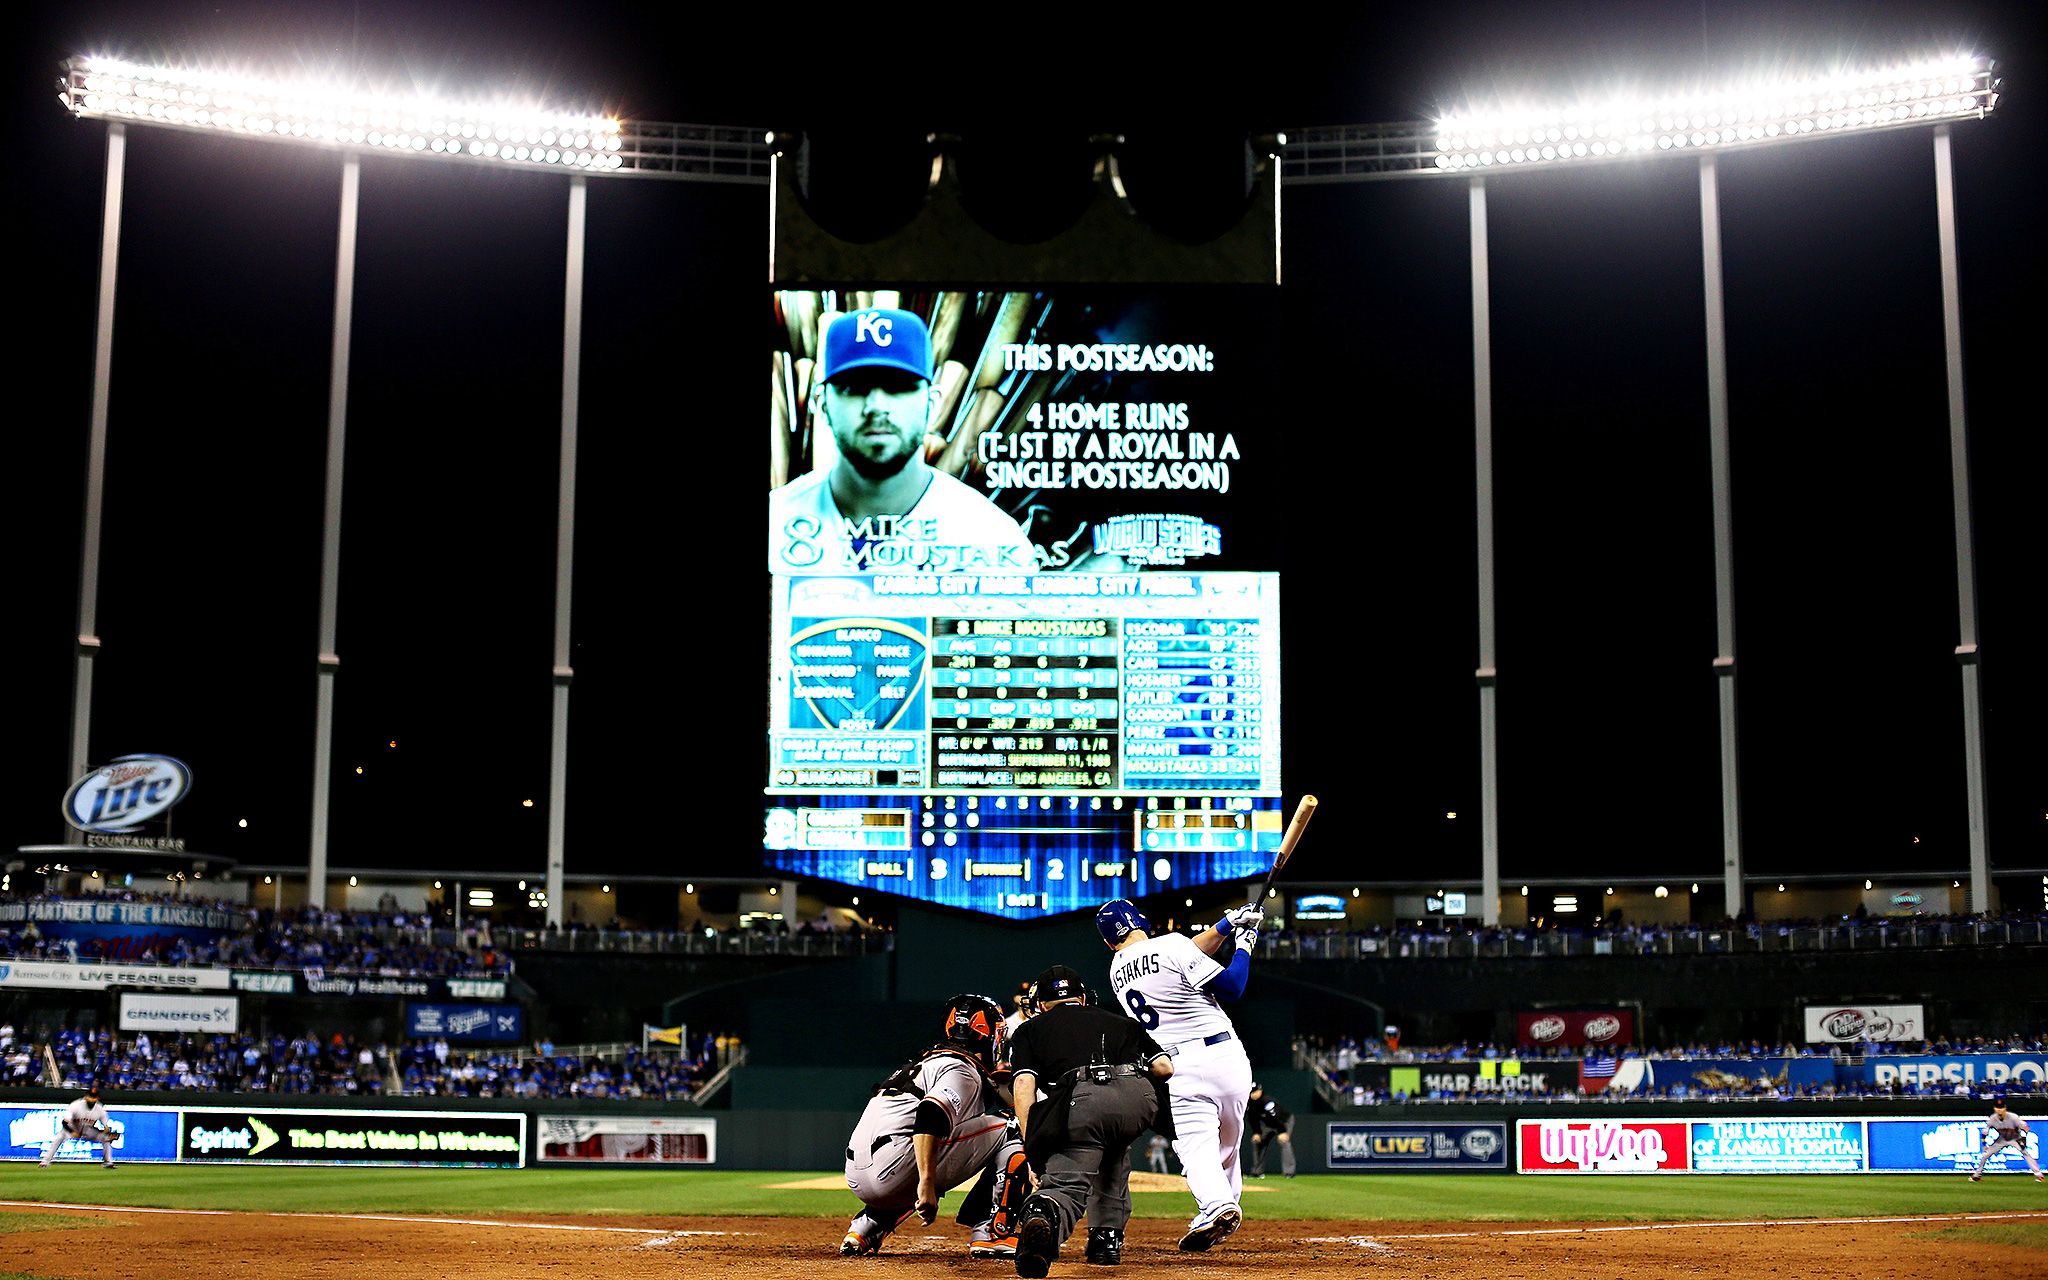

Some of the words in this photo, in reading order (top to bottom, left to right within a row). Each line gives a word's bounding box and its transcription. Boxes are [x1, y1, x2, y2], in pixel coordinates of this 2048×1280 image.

[855, 311, 893, 347] KC
[1000, 344, 1053, 372] THIS
[1057, 344, 1214, 372] POSTSEASON:
[1026, 403, 1043, 430] 4
[1048, 403, 1121, 430] HOME
[1125, 403, 1190, 430] RUNS
[978, 431, 1048, 463] (T-1ST
[1052, 433, 1081, 459] BY
[1083, 433, 1105, 459] A
[1108, 433, 1184, 460] ROYAL
[1189, 433, 1215, 460] IN
[1219, 433, 1240, 460] A
[986, 462, 1065, 489] SINGLE
[1071, 462, 1230, 493] POSTSEASON)
[843, 514, 937, 541] MIKE
[780, 516, 823, 567] 8
[840, 541, 1070, 567] MOUSTAKAS
[1015, 620, 1107, 636] MOUSTAKAS
[956, 686, 968, 699] 0
[996, 686, 1008, 699] 0
[1037, 686, 1048, 699] 4
[956, 717, 968, 730] 0
[1018, 737, 1044, 750] 215
[1126, 760, 1208, 774] MOUSTAKAS
[1014, 771, 1037, 785] LOS
[1038, 771, 1093, 786] ANGELES,
[1094, 771, 1112, 785] CA
[88, 778, 173, 824] Lite
[923, 796, 933, 810] 1
[945, 796, 956, 810] 2
[967, 796, 978, 810] 3
[996, 796, 1007, 810] 4
[1018, 796, 1029, 810] 5
[1068, 796, 1079, 810] 7
[922, 812, 935, 827] 3
[944, 812, 957, 827] 0
[966, 812, 980, 827] 0
[87, 835, 155, 848] FOUNTAIN
[158, 838, 185, 851] BAR
[921, 831, 935, 846] 0
[944, 831, 957, 846] 0
[1146, 832, 1159, 848] 0
[930, 858, 948, 880] 3
[1047, 858, 1064, 880] 2
[1153, 859, 1171, 881] 0
[28, 902, 93, 921] PARTNER
[96, 902, 115, 922] OF
[120, 902, 146, 923] THE
[151, 905, 205, 928] KANSAS
[79, 971, 113, 983] LIVE
[118, 972, 197, 985] FEARLESS
[232, 974, 293, 993] TEVA
[307, 978, 356, 996] Quality
[447, 981, 506, 998] TEVA
[127, 1010, 211, 1022] GRUNDFOS
[1125, 988, 1160, 1031] 8
[1426, 1074, 1470, 1091] H&R
[1986, 1061, 2048, 1086] PO
[190, 1126, 251, 1153] Sprint
[288, 1129, 325, 1148] The
[1710, 1122, 1744, 1139] THE
[1746, 1122, 1844, 1139] UNIVERSITY
[1331, 1133, 1370, 1150] FOX
[1374, 1137, 1427, 1153] LIVE
[1693, 1139, 1716, 1155] OF
[1719, 1137, 1781, 1155] KANSAS
[1785, 1136, 1862, 1155] HOSPITAL
